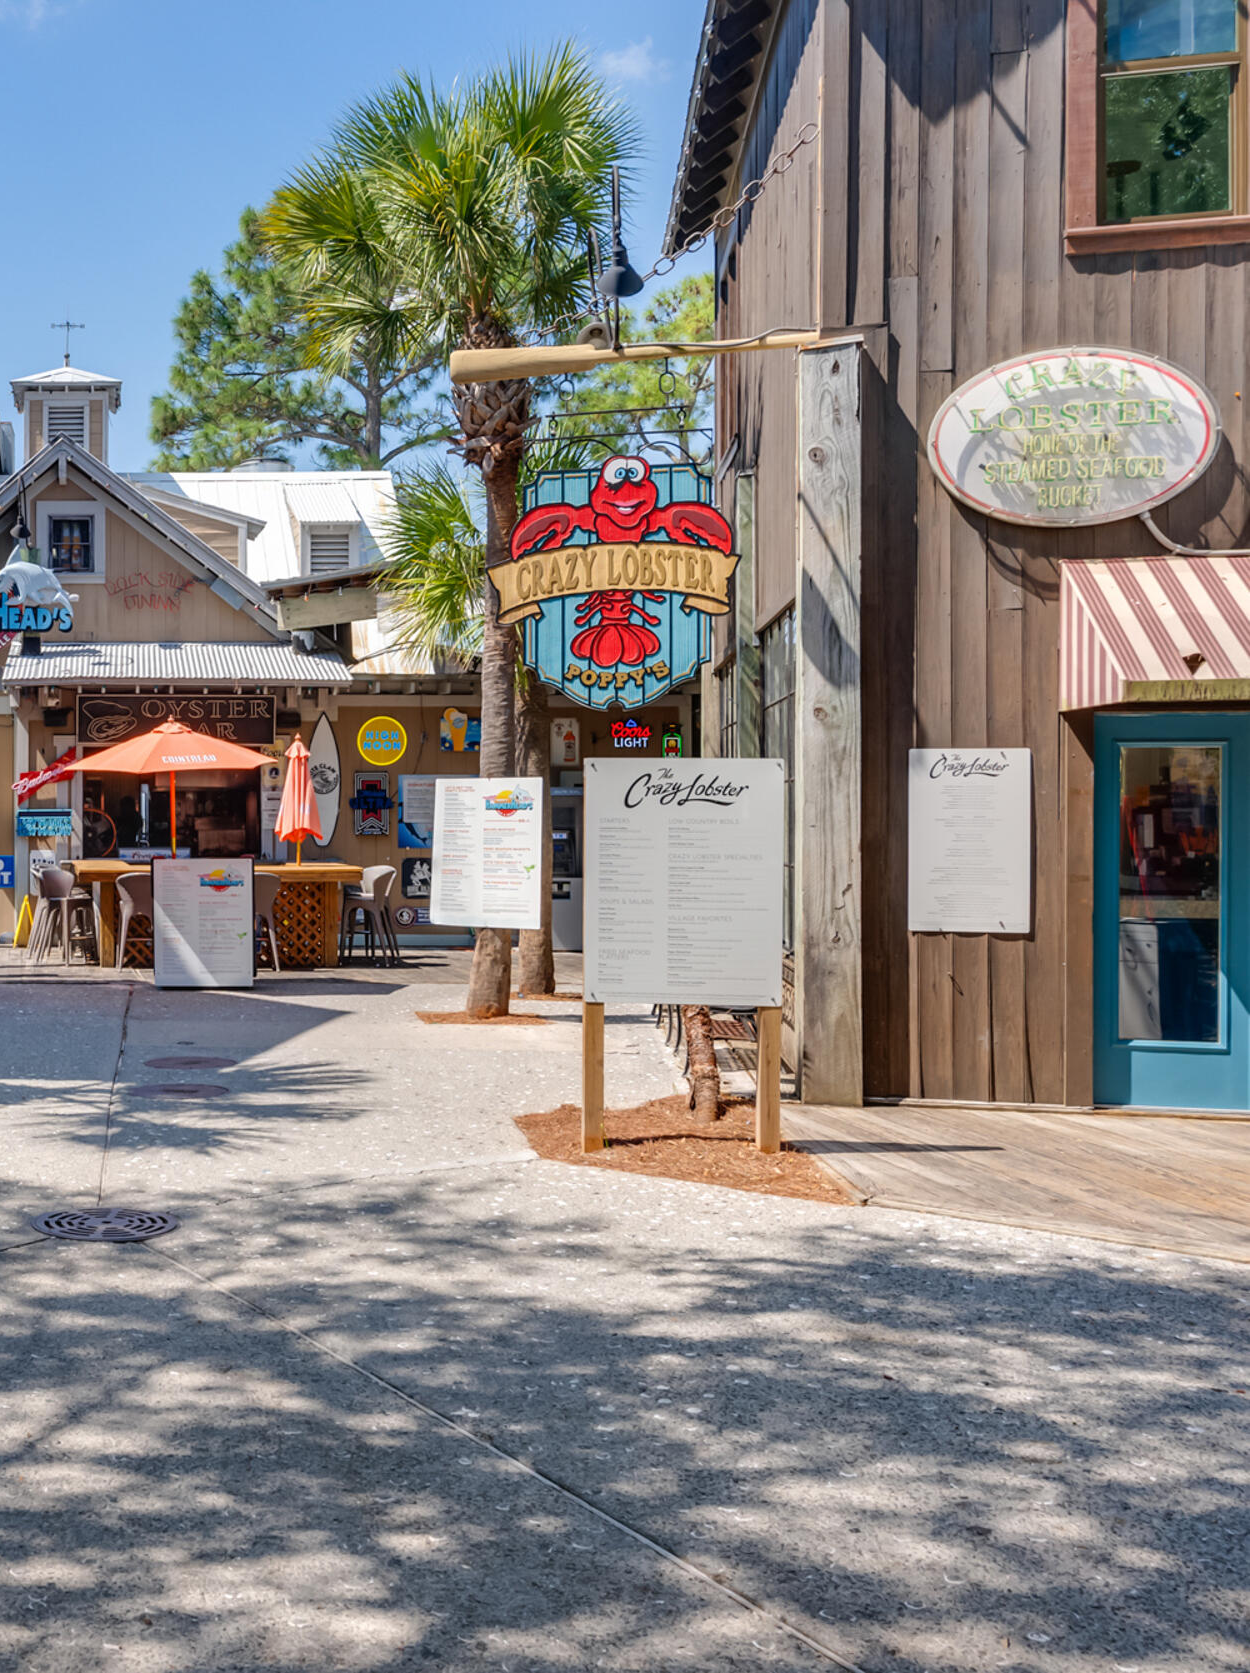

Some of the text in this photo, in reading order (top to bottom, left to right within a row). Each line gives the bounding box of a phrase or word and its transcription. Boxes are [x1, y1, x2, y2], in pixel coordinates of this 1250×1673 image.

[1005, 358, 1142, 400] CRAZY
[969, 398, 1179, 434] LOBSTER
[1023, 432, 1120, 456] HOME OF THE
[983, 455, 1167, 486] STEAMED SEAFOOD
[1038, 484, 1103, 509] BUCKET
[516, 548, 716, 600] CRAZY LOBSTER
[564, 660, 671, 689] POPPY'S
[140, 699, 271, 719] OYSTER
[365, 730, 399, 740] HIGH
[610, 721, 653, 738] Coors
[363, 741, 402, 751] NOON
[613, 737, 649, 748] LIGHT
[658, 767, 674, 781] The
[930, 756, 1010, 780] Crazy Lobster
[624, 772, 750, 809] Crazy Lobster
